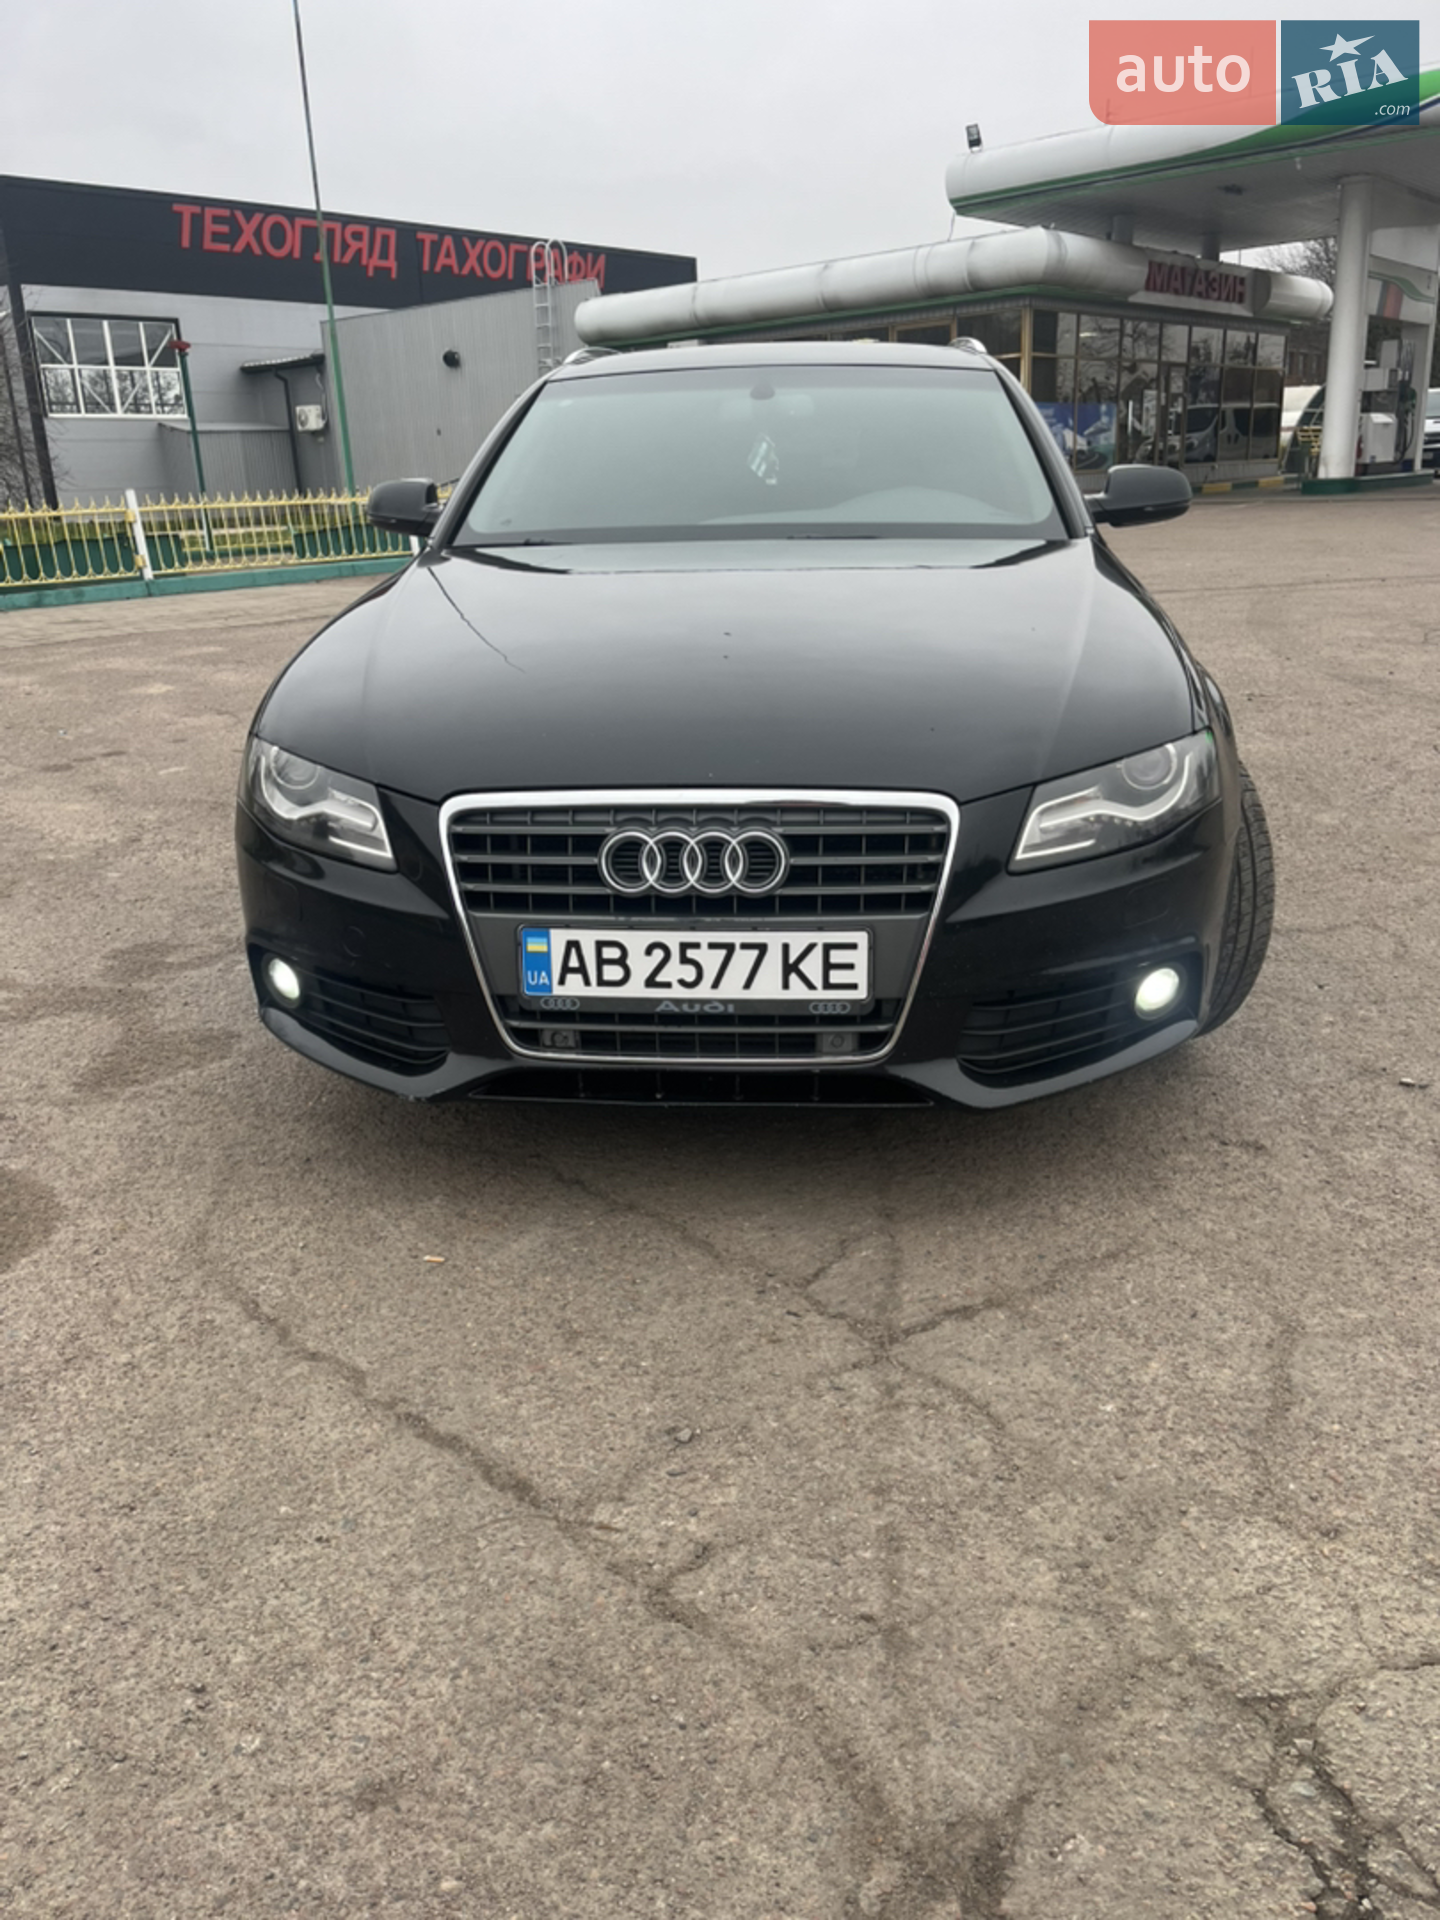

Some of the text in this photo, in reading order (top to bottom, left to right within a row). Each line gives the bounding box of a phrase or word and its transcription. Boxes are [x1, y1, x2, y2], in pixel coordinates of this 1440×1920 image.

[172, 202, 606, 289] ТЕХОГЛЯД ТАХОГРАФИ
[1144, 260, 1246, 304] МАГАЗИН
[527, 970, 550, 986] UA
[557, 939, 859, 991] AB 2577 KE
[655, 1001, 735, 1014] Audi
